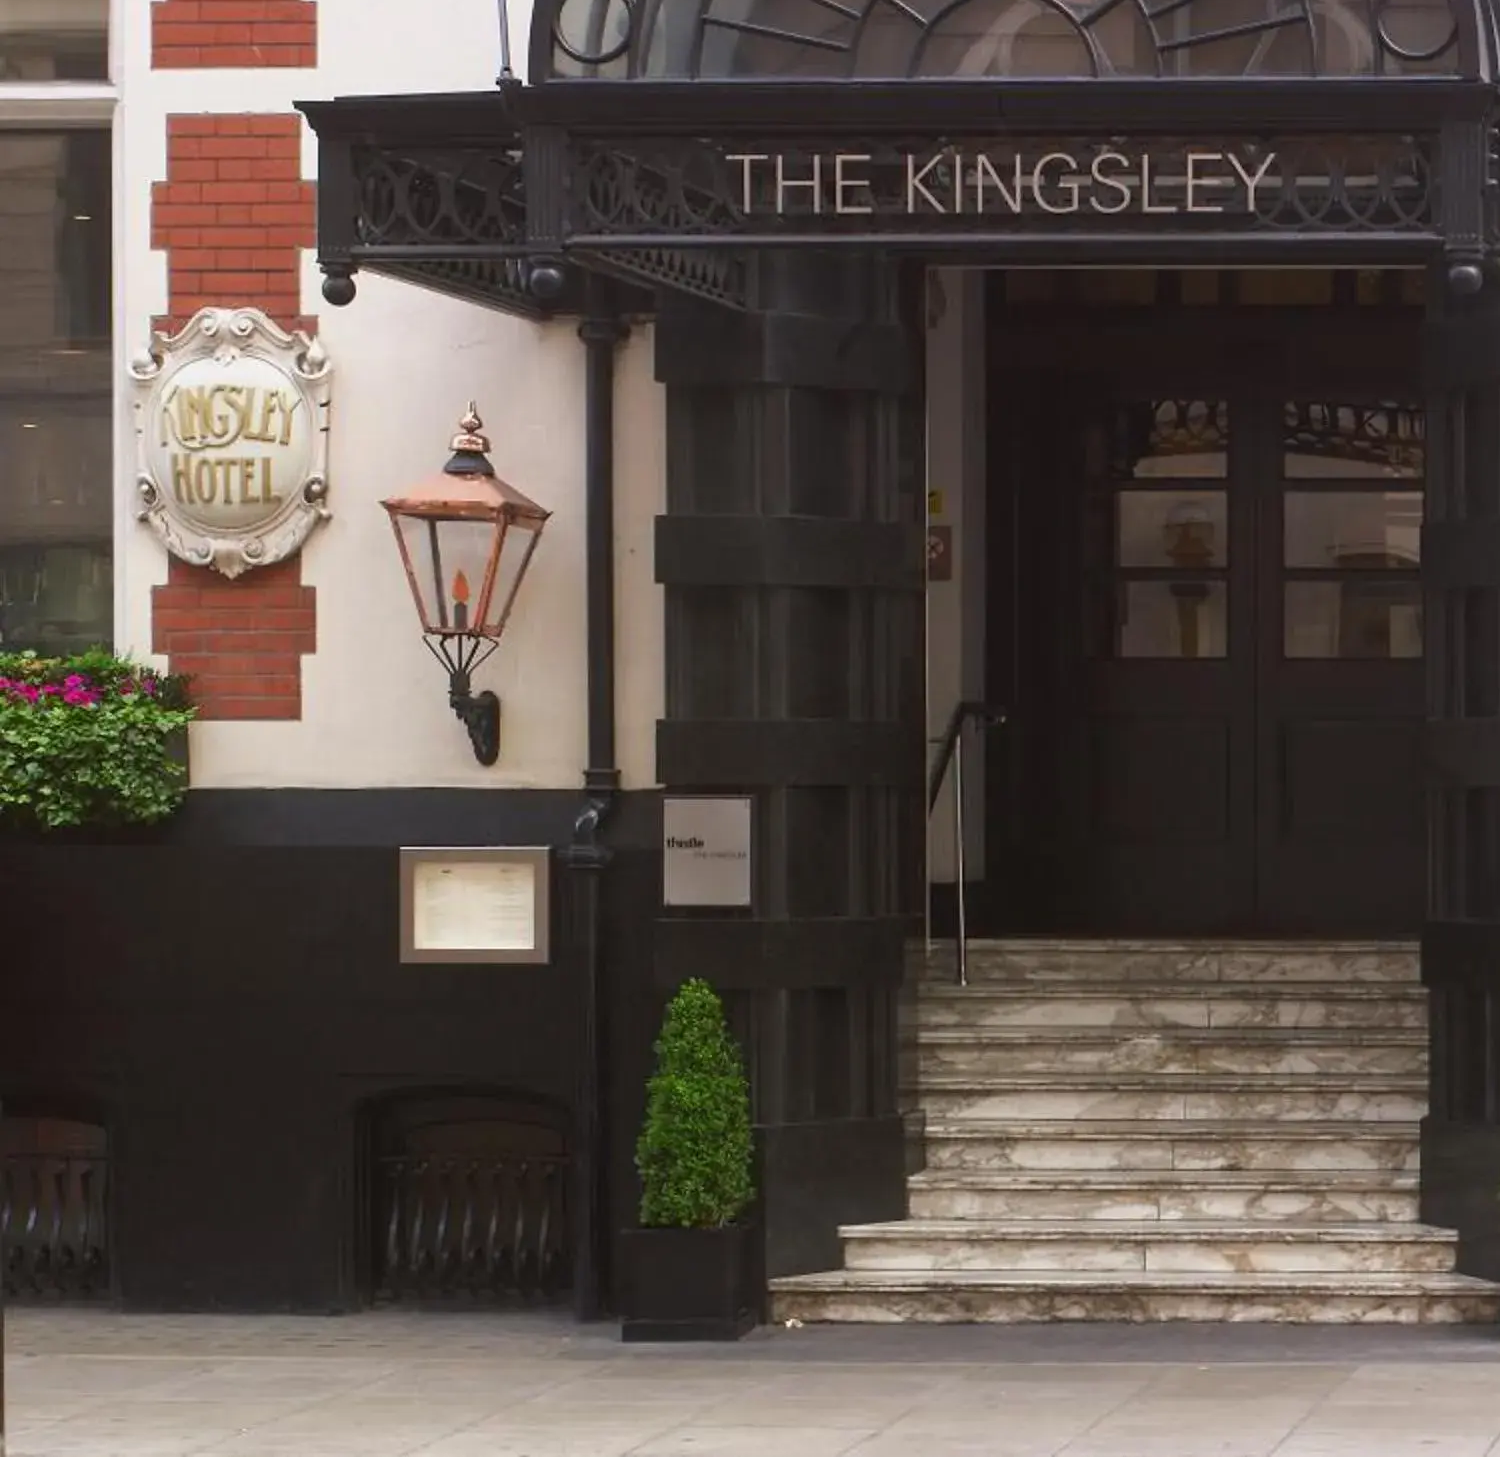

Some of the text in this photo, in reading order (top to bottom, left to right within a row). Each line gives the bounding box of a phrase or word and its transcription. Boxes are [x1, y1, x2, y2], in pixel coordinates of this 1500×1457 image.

[725, 152, 1276, 214] THE KINGSLEY
[160, 385, 302, 450] KINGSLEY
[171, 452, 283, 505] HOTEL
